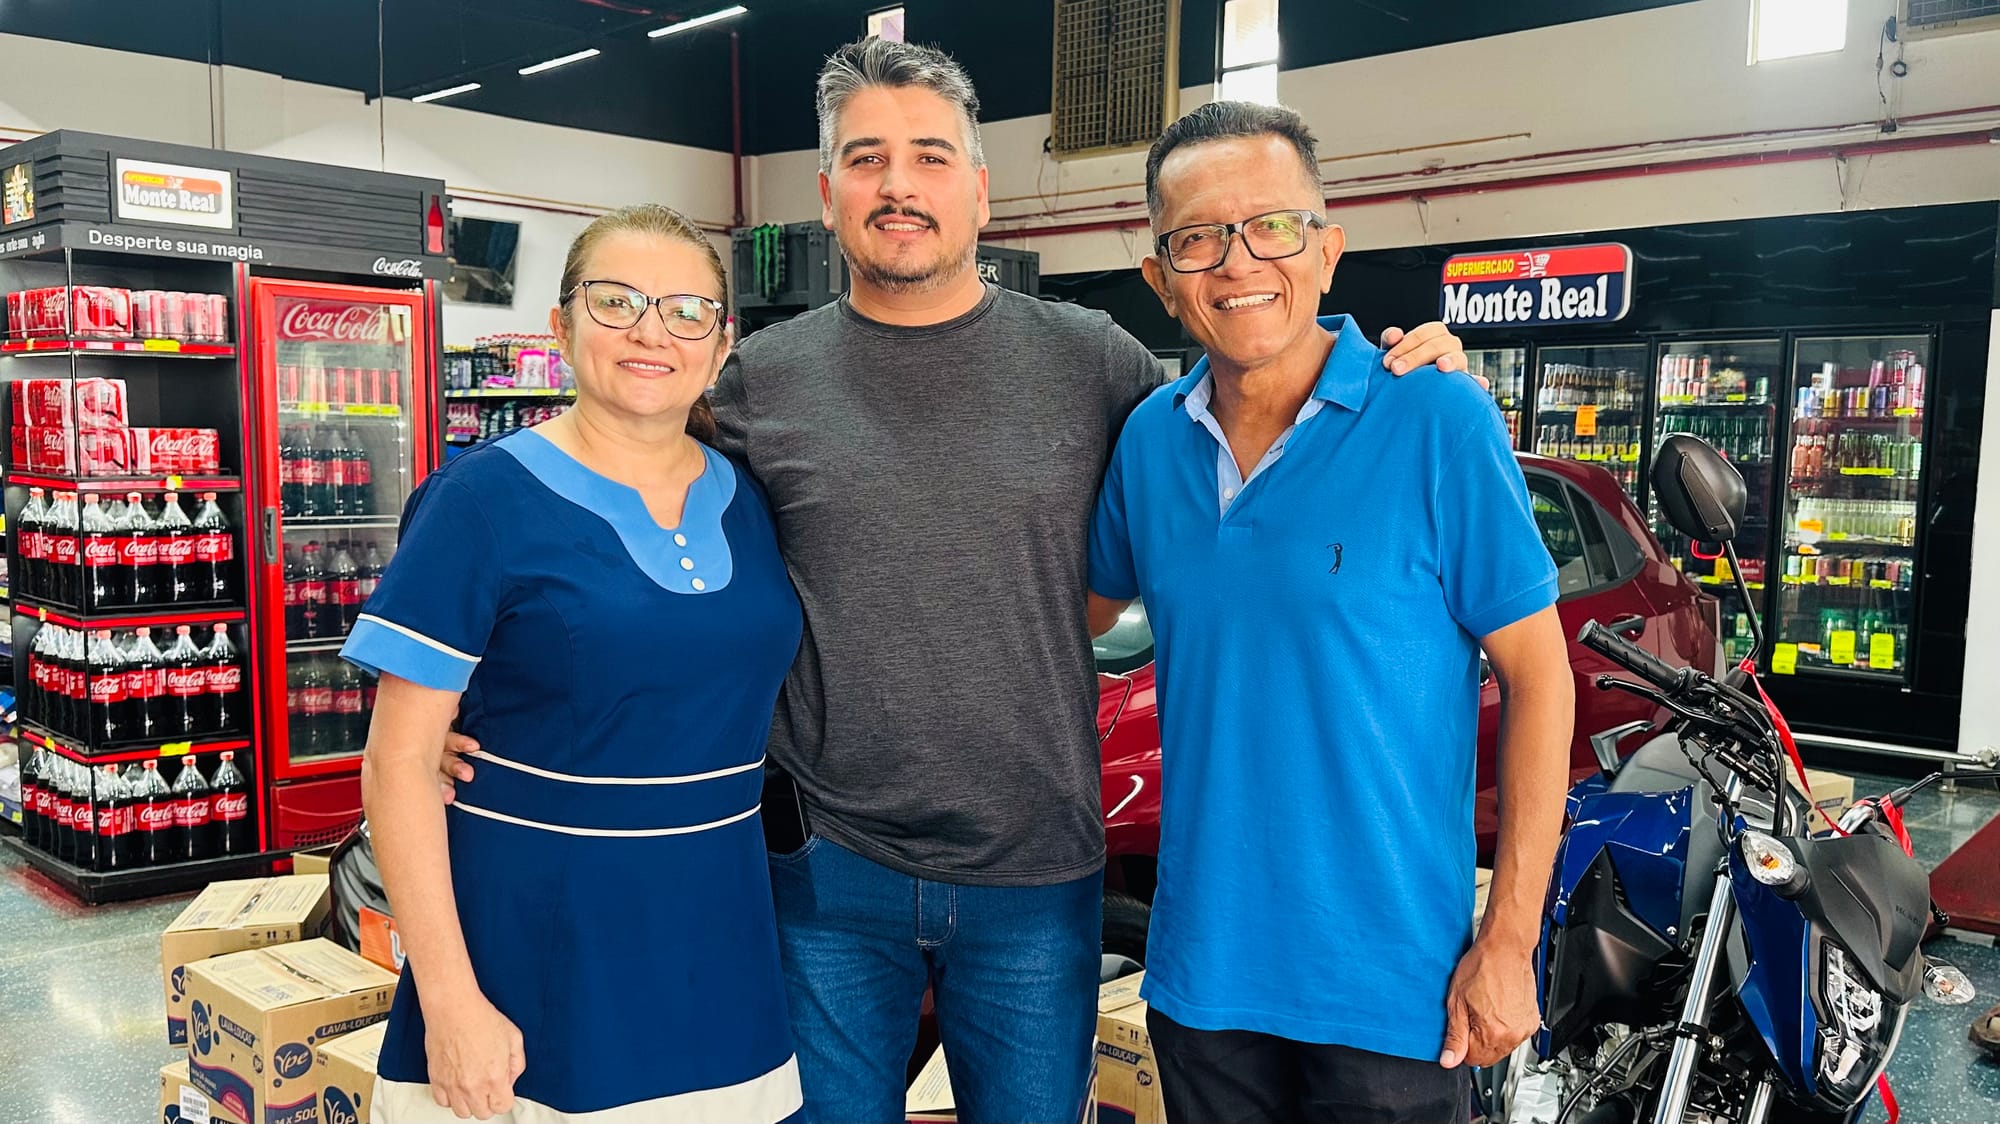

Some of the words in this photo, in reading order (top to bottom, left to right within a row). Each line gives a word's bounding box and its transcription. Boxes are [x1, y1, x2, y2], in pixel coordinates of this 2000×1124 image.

[124, 183, 176, 208] Monte
[178, 190, 216, 213] Real
[89, 229, 172, 250] Desperte
[176, 240, 208, 255] sua
[212, 242, 264, 261] magia
[1446, 258, 1515, 278] SUPERMERCADO
[1442, 283, 1534, 325] Monte
[1538, 275, 1609, 321] Real
